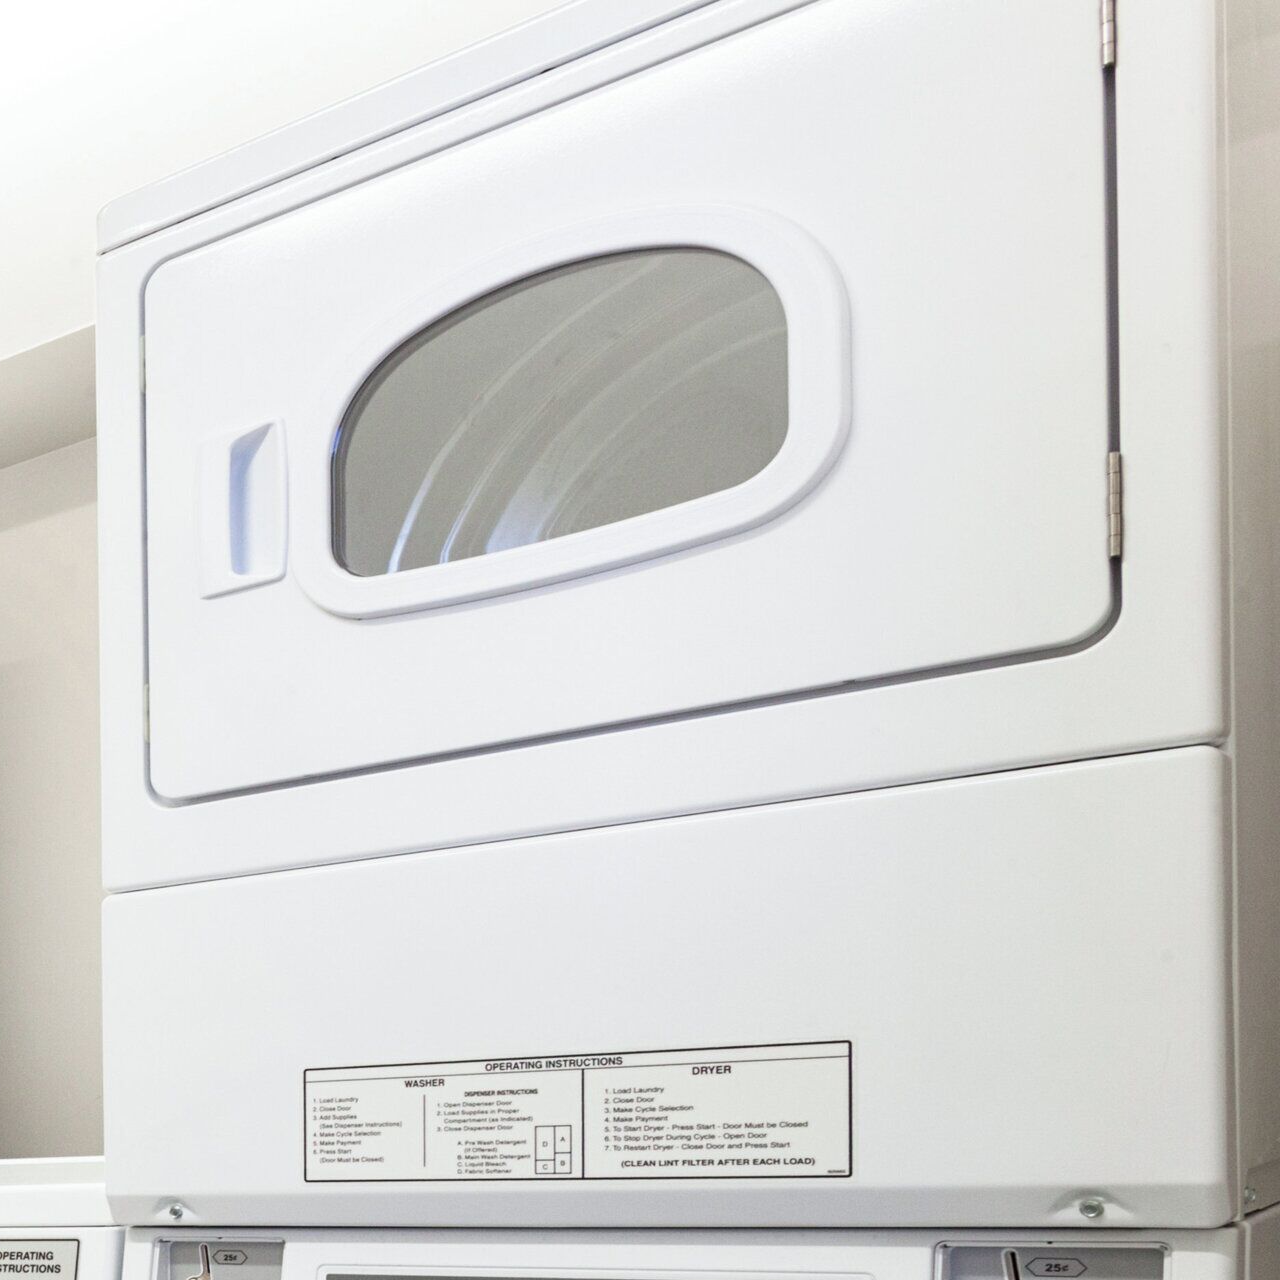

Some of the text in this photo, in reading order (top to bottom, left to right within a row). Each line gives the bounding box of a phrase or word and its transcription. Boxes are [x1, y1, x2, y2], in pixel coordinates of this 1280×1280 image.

[485, 1057, 622, 1072] OPERATING INSTRUCTIONS
[692, 1066, 731, 1075] DRYER
[404, 1079, 445, 1088] WASHER
[1045, 1263, 1069, 1273] 25¢
